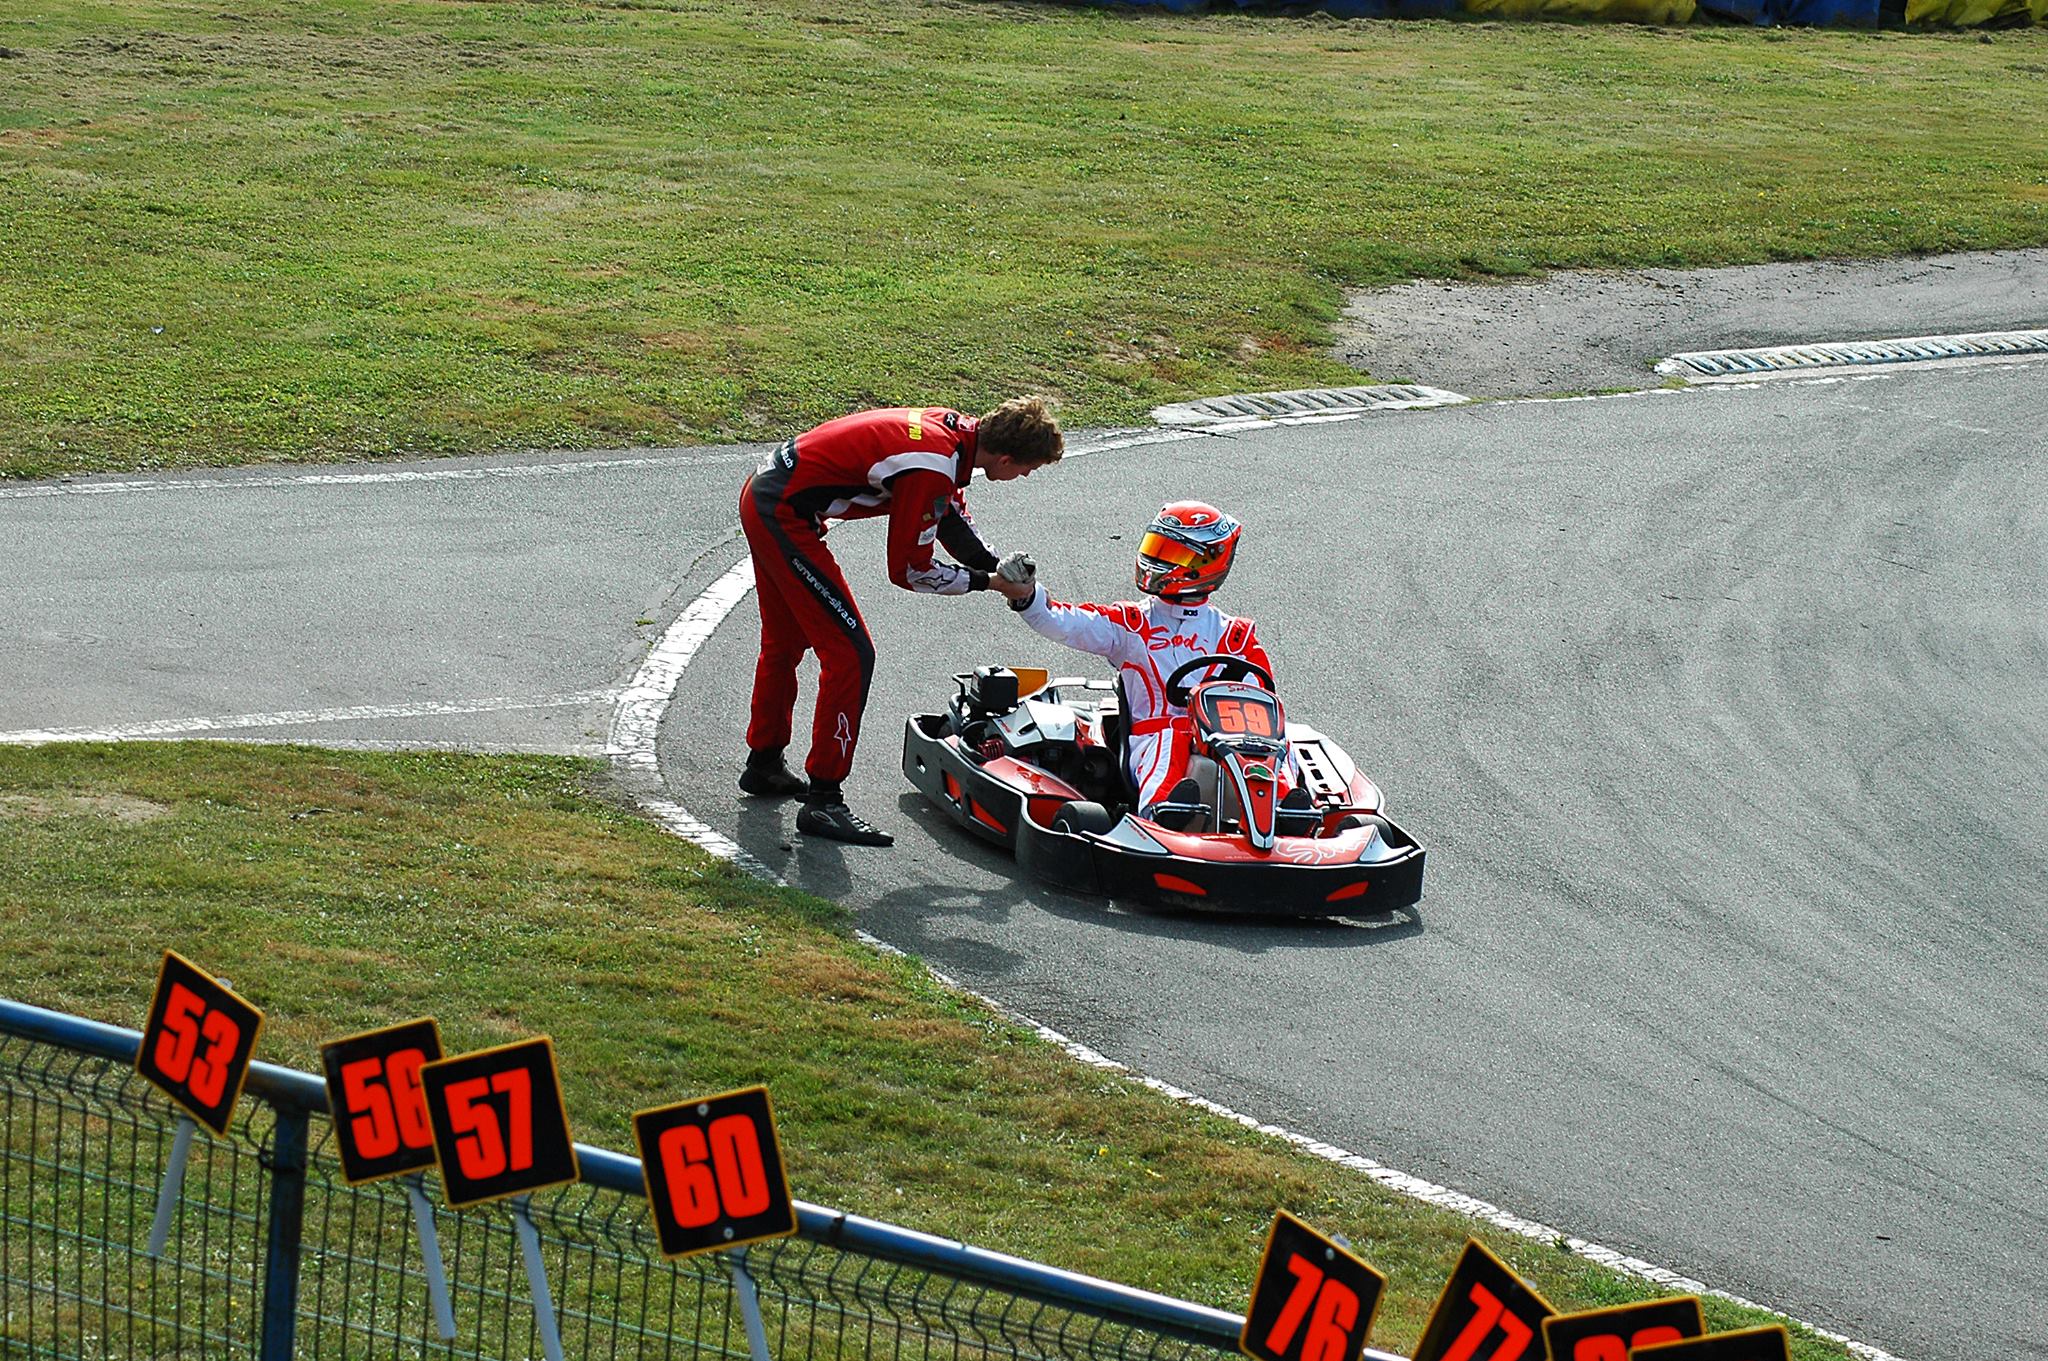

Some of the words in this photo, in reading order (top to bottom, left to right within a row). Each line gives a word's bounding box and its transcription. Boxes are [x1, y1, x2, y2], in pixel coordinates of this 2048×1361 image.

[1215, 700, 1272, 737] 59
[155, 982, 240, 1108] 53
[341, 1048, 435, 1160] 56
[443, 1067, 533, 1181] 57
[658, 1113, 771, 1229] 60
[1264, 1253, 1360, 1361] 76
